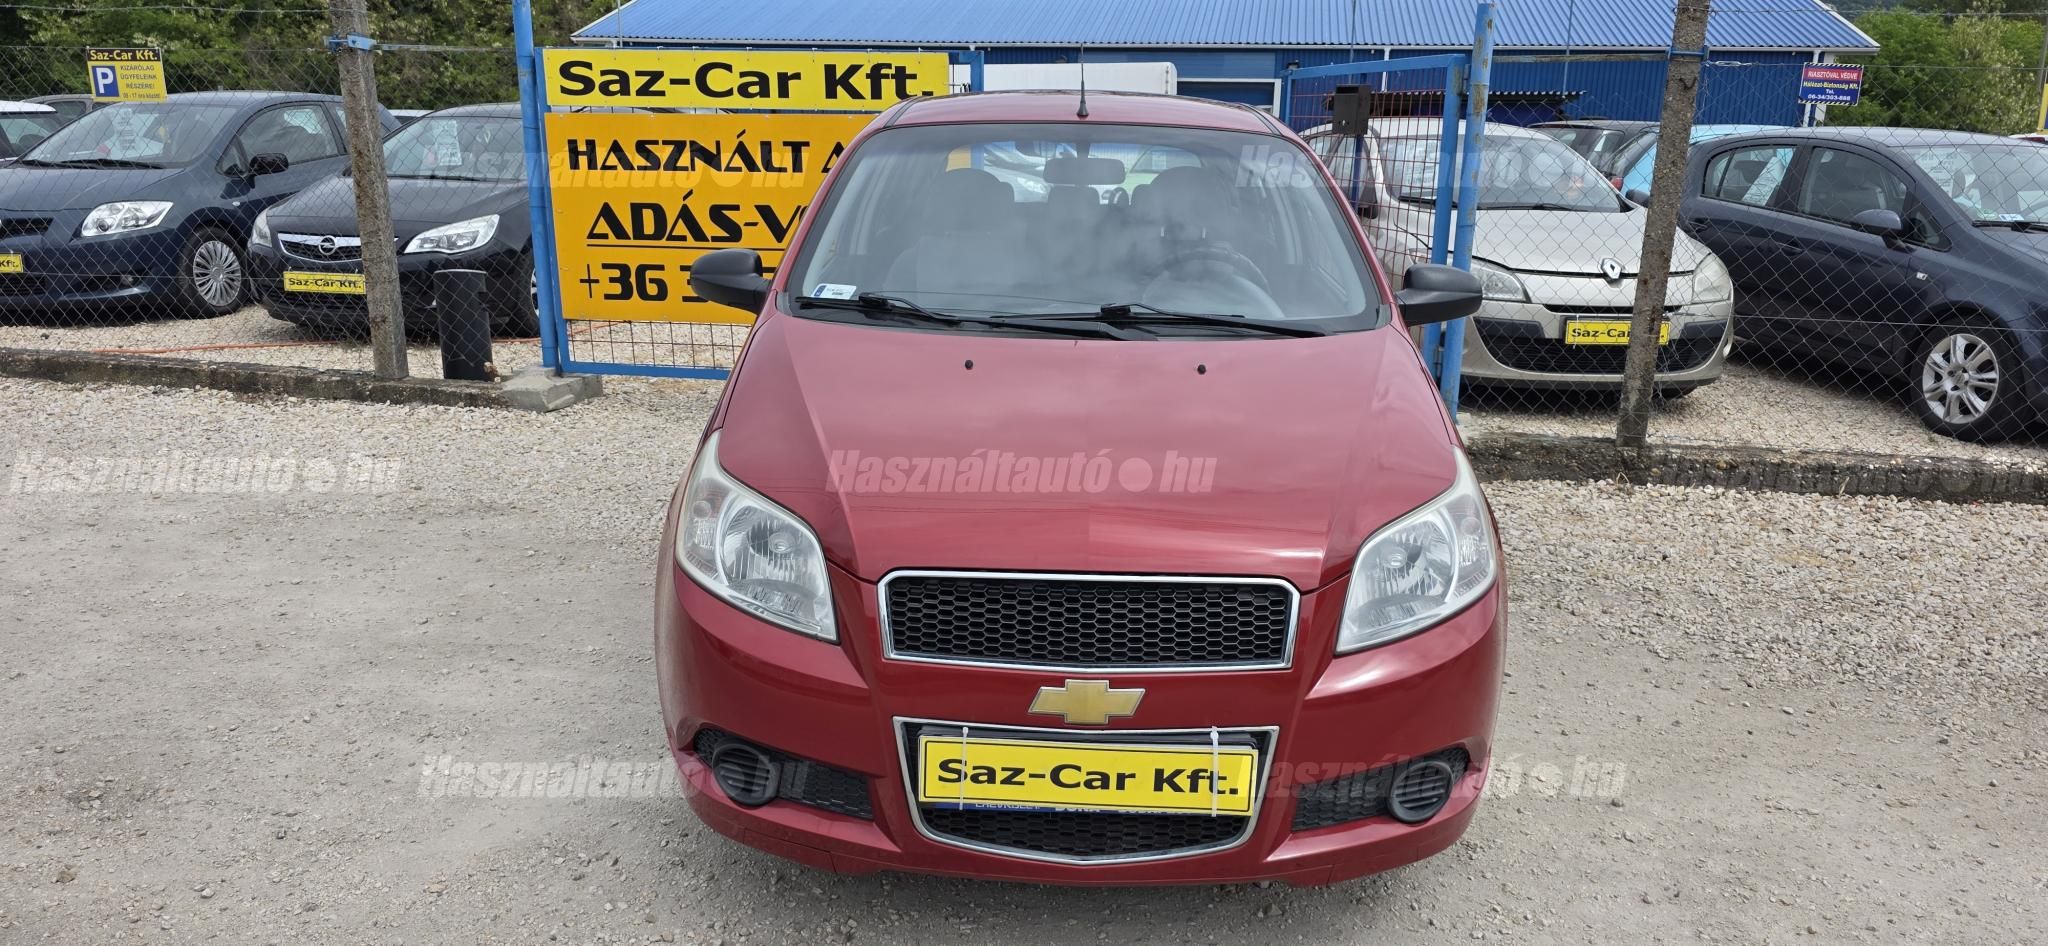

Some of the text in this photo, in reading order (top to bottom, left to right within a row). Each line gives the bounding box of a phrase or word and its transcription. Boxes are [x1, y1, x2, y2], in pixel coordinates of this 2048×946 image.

[90, 50, 157, 60] Saz-Car Kft.
[96, 68, 113, 93] P
[558, 60, 934, 101] Saz-Car Kft.
[1807, 71, 1859, 80] RIASZTÓVAL VÉDVE
[566, 128, 811, 174] HASZNÁLT
[586, 189, 808, 244] ADÁS-V
[288, 277, 336, 288] Saz-Car
[579, 262, 669, 302] +36
[937, 758, 1239, 796] Saz-Car Kft.
